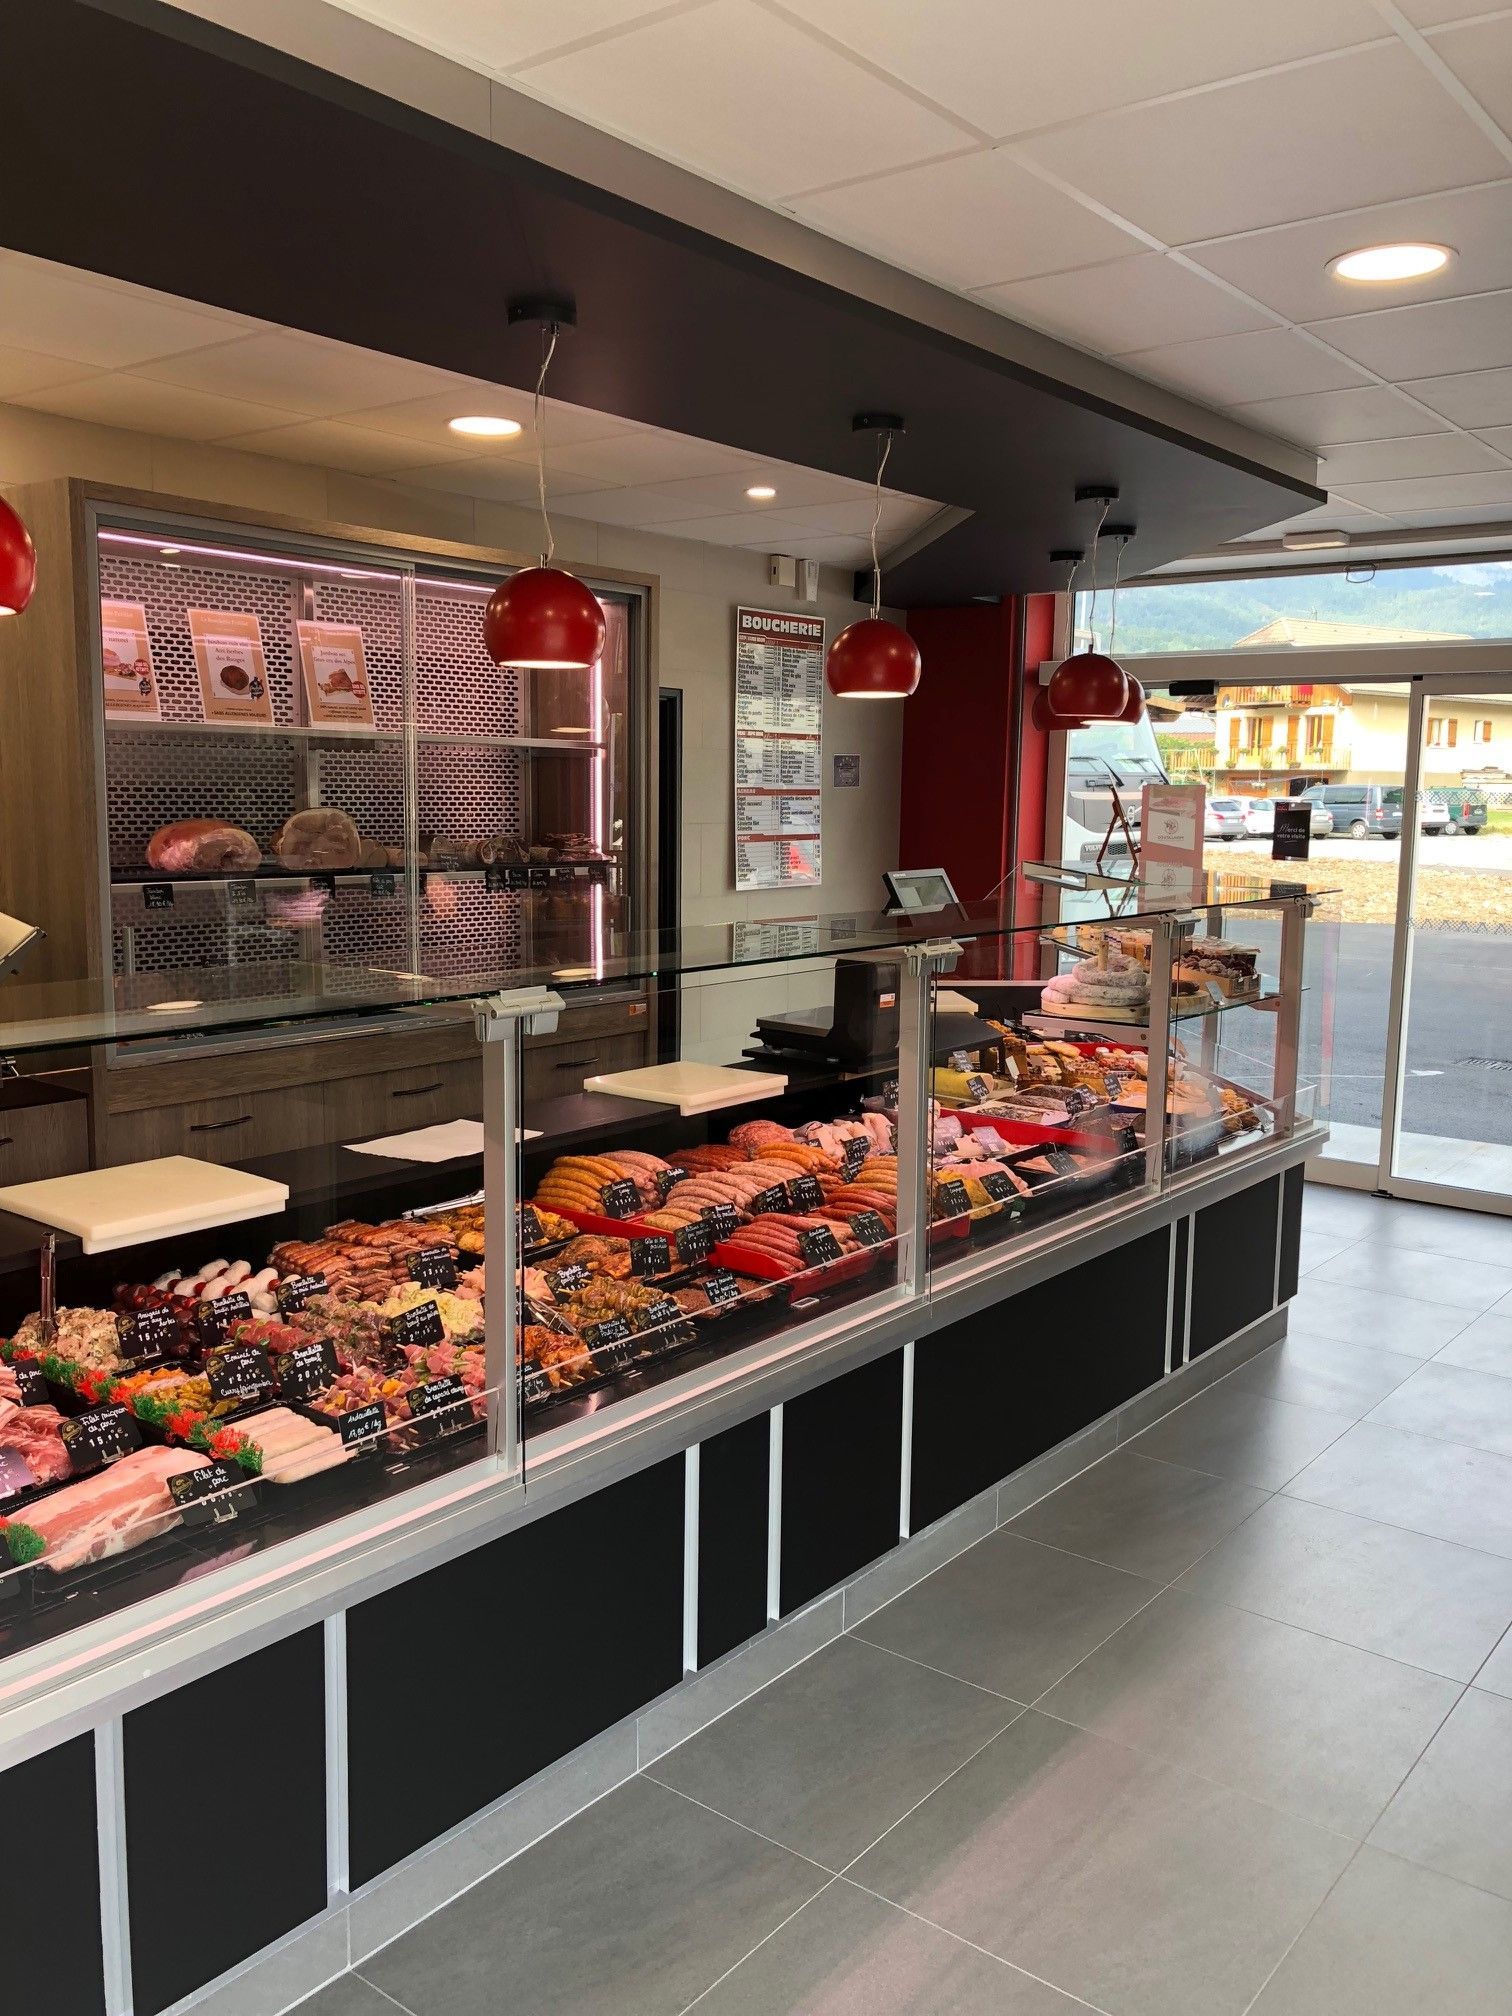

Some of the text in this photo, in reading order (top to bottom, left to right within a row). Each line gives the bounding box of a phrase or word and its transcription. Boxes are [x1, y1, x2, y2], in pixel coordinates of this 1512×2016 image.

[742, 615, 821, 636] BOUCHERIE
[1278, 825, 1298, 833] Merci
[138, 1320, 150, 1330] porc
[251, 1349, 262, 1357] de
[240, 1358, 255, 1369] porc
[18, 1370, 42, 1380] de porc
[80, 1406, 129, 1426] Filet mignon
[88, 1418, 116, 1433] de porc
[193, 1466, 227, 1483] Filet de
[211, 1475, 229, 1488] porc
